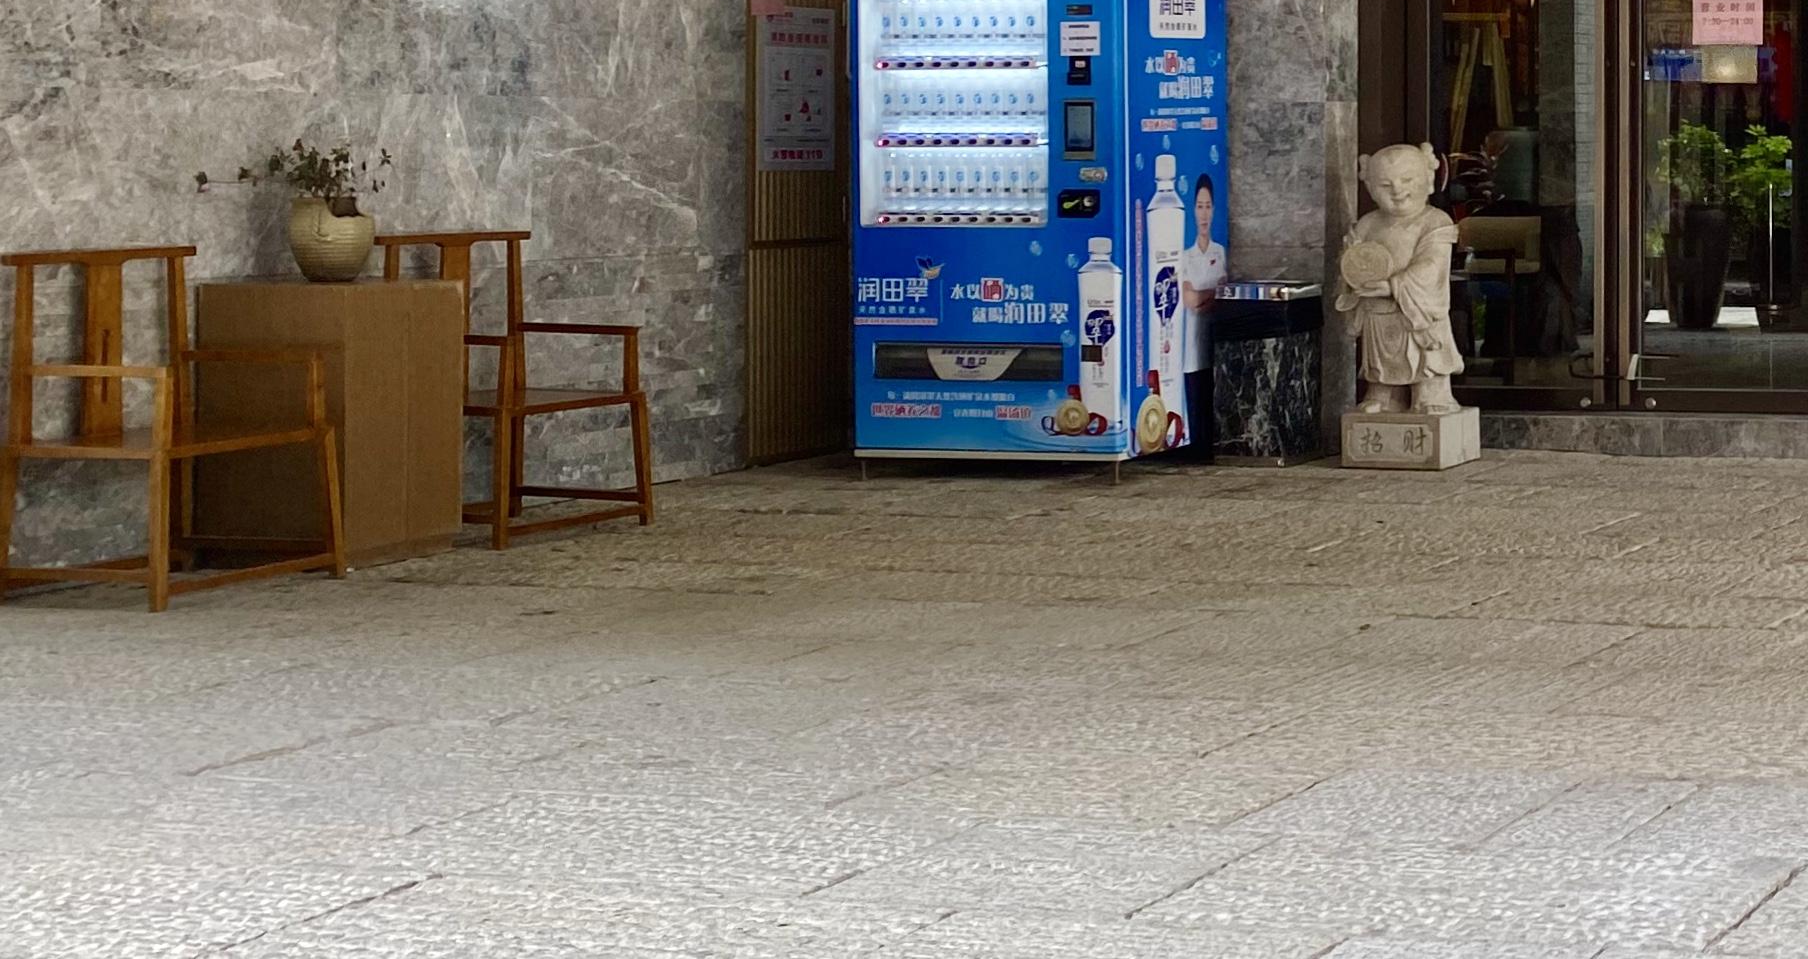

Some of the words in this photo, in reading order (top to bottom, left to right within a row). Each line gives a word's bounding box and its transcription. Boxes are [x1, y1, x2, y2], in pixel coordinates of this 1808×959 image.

[858, 277, 928, 303] 润田翠
[1360, 427, 1427, 456] 招财
